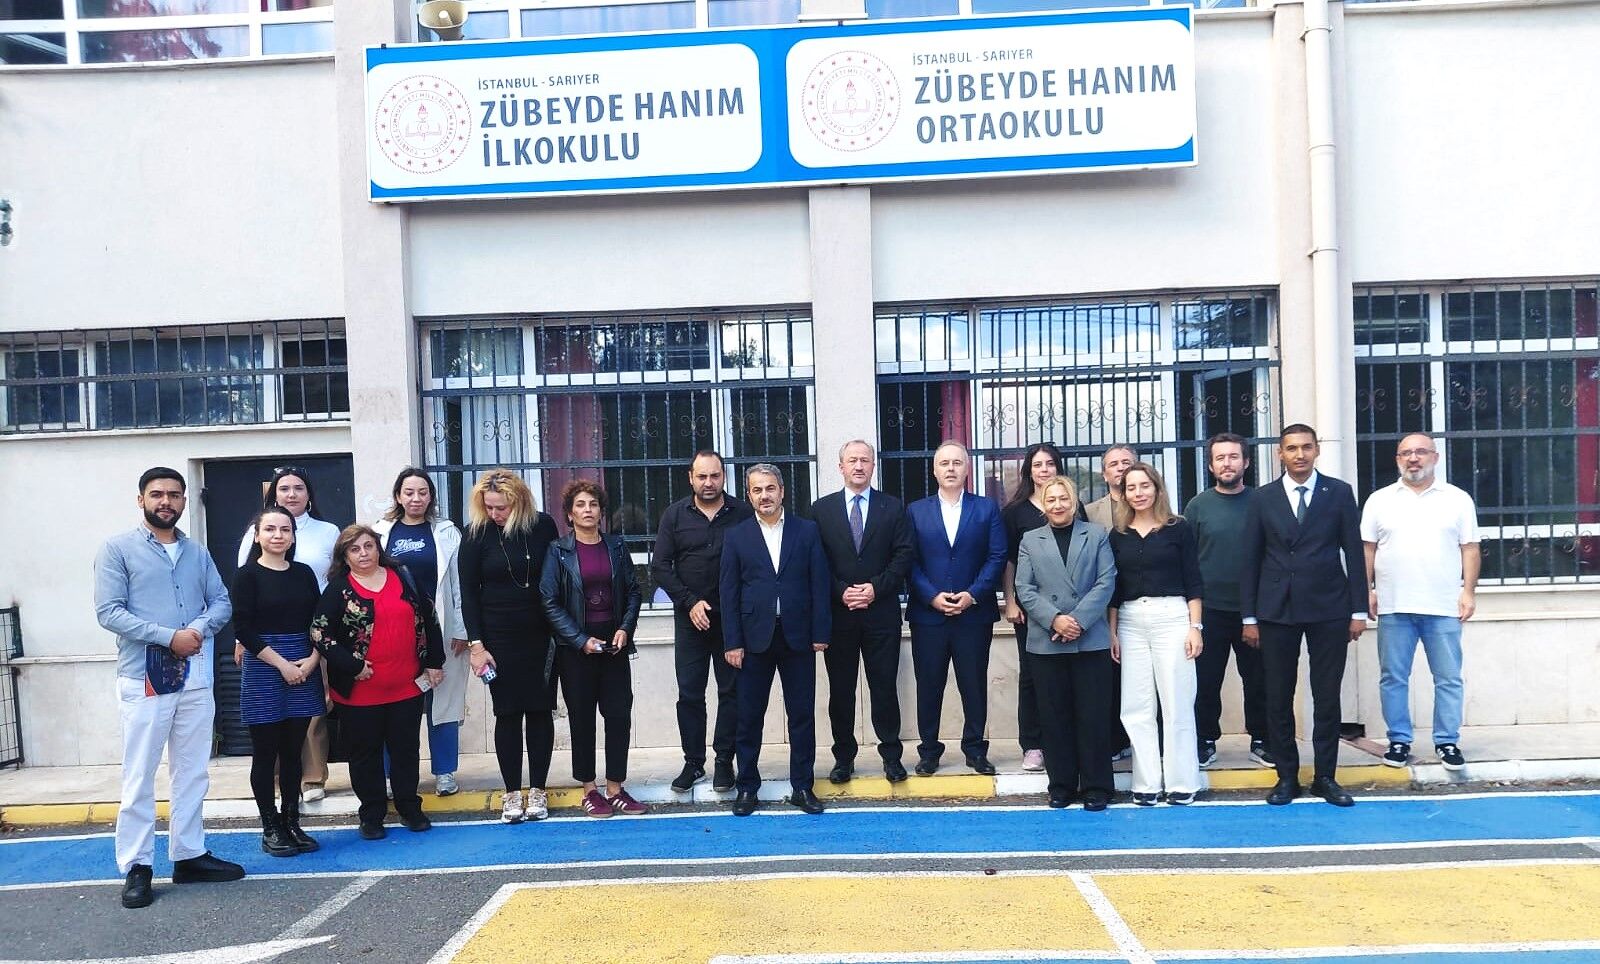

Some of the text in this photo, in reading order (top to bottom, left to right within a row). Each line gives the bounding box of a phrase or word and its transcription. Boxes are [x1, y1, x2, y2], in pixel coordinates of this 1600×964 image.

[913, 52, 972, 66] İSTANBUL
[983, 49, 1033, 62] SARIYER
[478, 77, 539, 90] İSTANBUL
[548, 73, 600, 86] SARIYER
[914, 68, 1057, 104] ZÜBEYDE
[1068, 64, 1176, 96] HANIM
[480, 87, 744, 128] ZÜBEYDE HANIM
[916, 107, 1104, 144] ORTAOKULU
[483, 133, 640, 167] İLKOKULU
